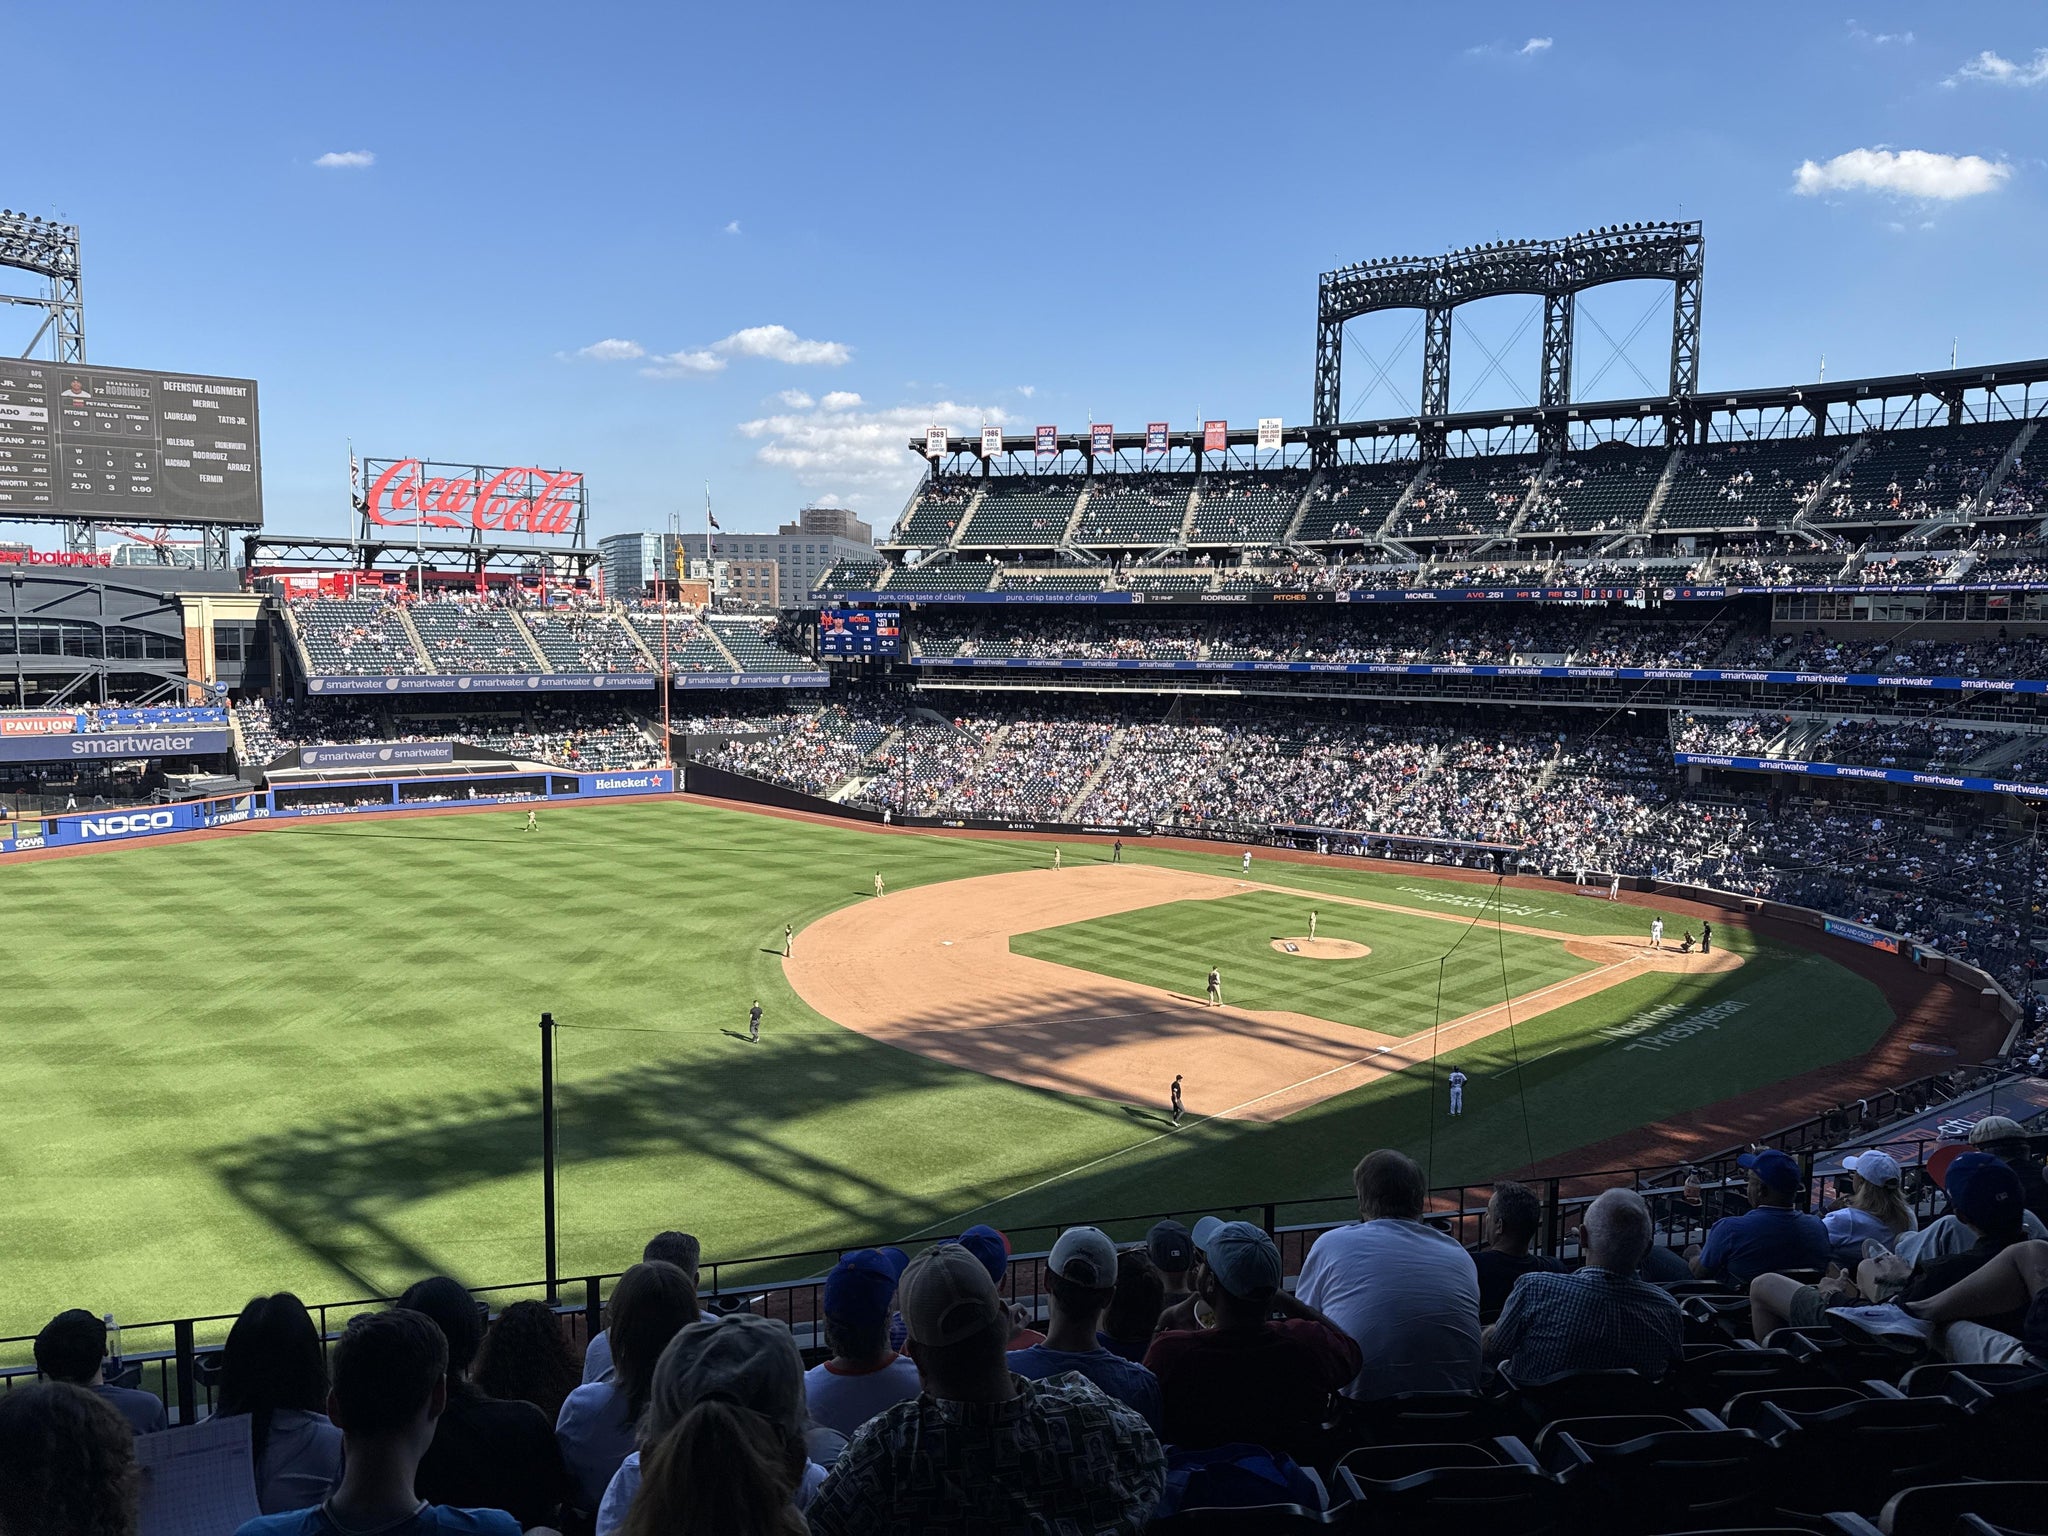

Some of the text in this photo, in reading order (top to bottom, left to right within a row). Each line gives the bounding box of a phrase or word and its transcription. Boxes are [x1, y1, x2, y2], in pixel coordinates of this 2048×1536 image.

[106, 386, 150, 398] RODRIGUEZ
[164, 381, 247, 397] DEFENSIVE ALIGNMENT
[192, 400, 220, 408] MERRILL
[164, 412, 196, 422] LAUREANO
[218, 416, 236, 424] TATIS
[166, 438, 194, 447] IGLESIAS
[192, 451, 228, 460] RODRIGUEZ
[228, 463, 251, 472] ARRAEZ
[200, 474, 223, 483] FERMIN
[367, 457, 584, 534] Coca-Cola
[28, 548, 111, 564] balance
[943, 594, 966, 602] clarity
[1074, 594, 1098, 602] clarity
[326, 677, 653, 689] smartwater smartwater smartwater smartwater smartwater
[1432, 666, 1474, 674] smartwater
[1498, 667, 1542, 675] smartwater
[1568, 668, 1615, 677] smartwater
[1644, 670, 1693, 678] smartwater
[1720, 672, 1768, 680] smartwater
[1796, 673, 1848, 683] smartwater
[1878, 676, 1933, 686] smartwater
[1961, 679, 2015, 690] smartwater
[72, 735, 194, 754] smartwater
[319, 748, 448, 761] smartwater smartwater
[1688, 755, 1733, 765] smartwater
[1759, 761, 1808, 771] smartwater
[1836, 766, 1887, 778] smartwater
[1913, 774, 1964, 786] smartwater
[596, 777, 648, 790] Heineken
[497, 795, 548, 804] CADILLAC
[254, 808, 270, 818] 370
[301, 806, 359, 816] CADILLAC
[81, 812, 174, 838] NOCO
[15, 837, 45, 848] GOYA
[1636, 1000, 1750, 1046] Presbyterian
